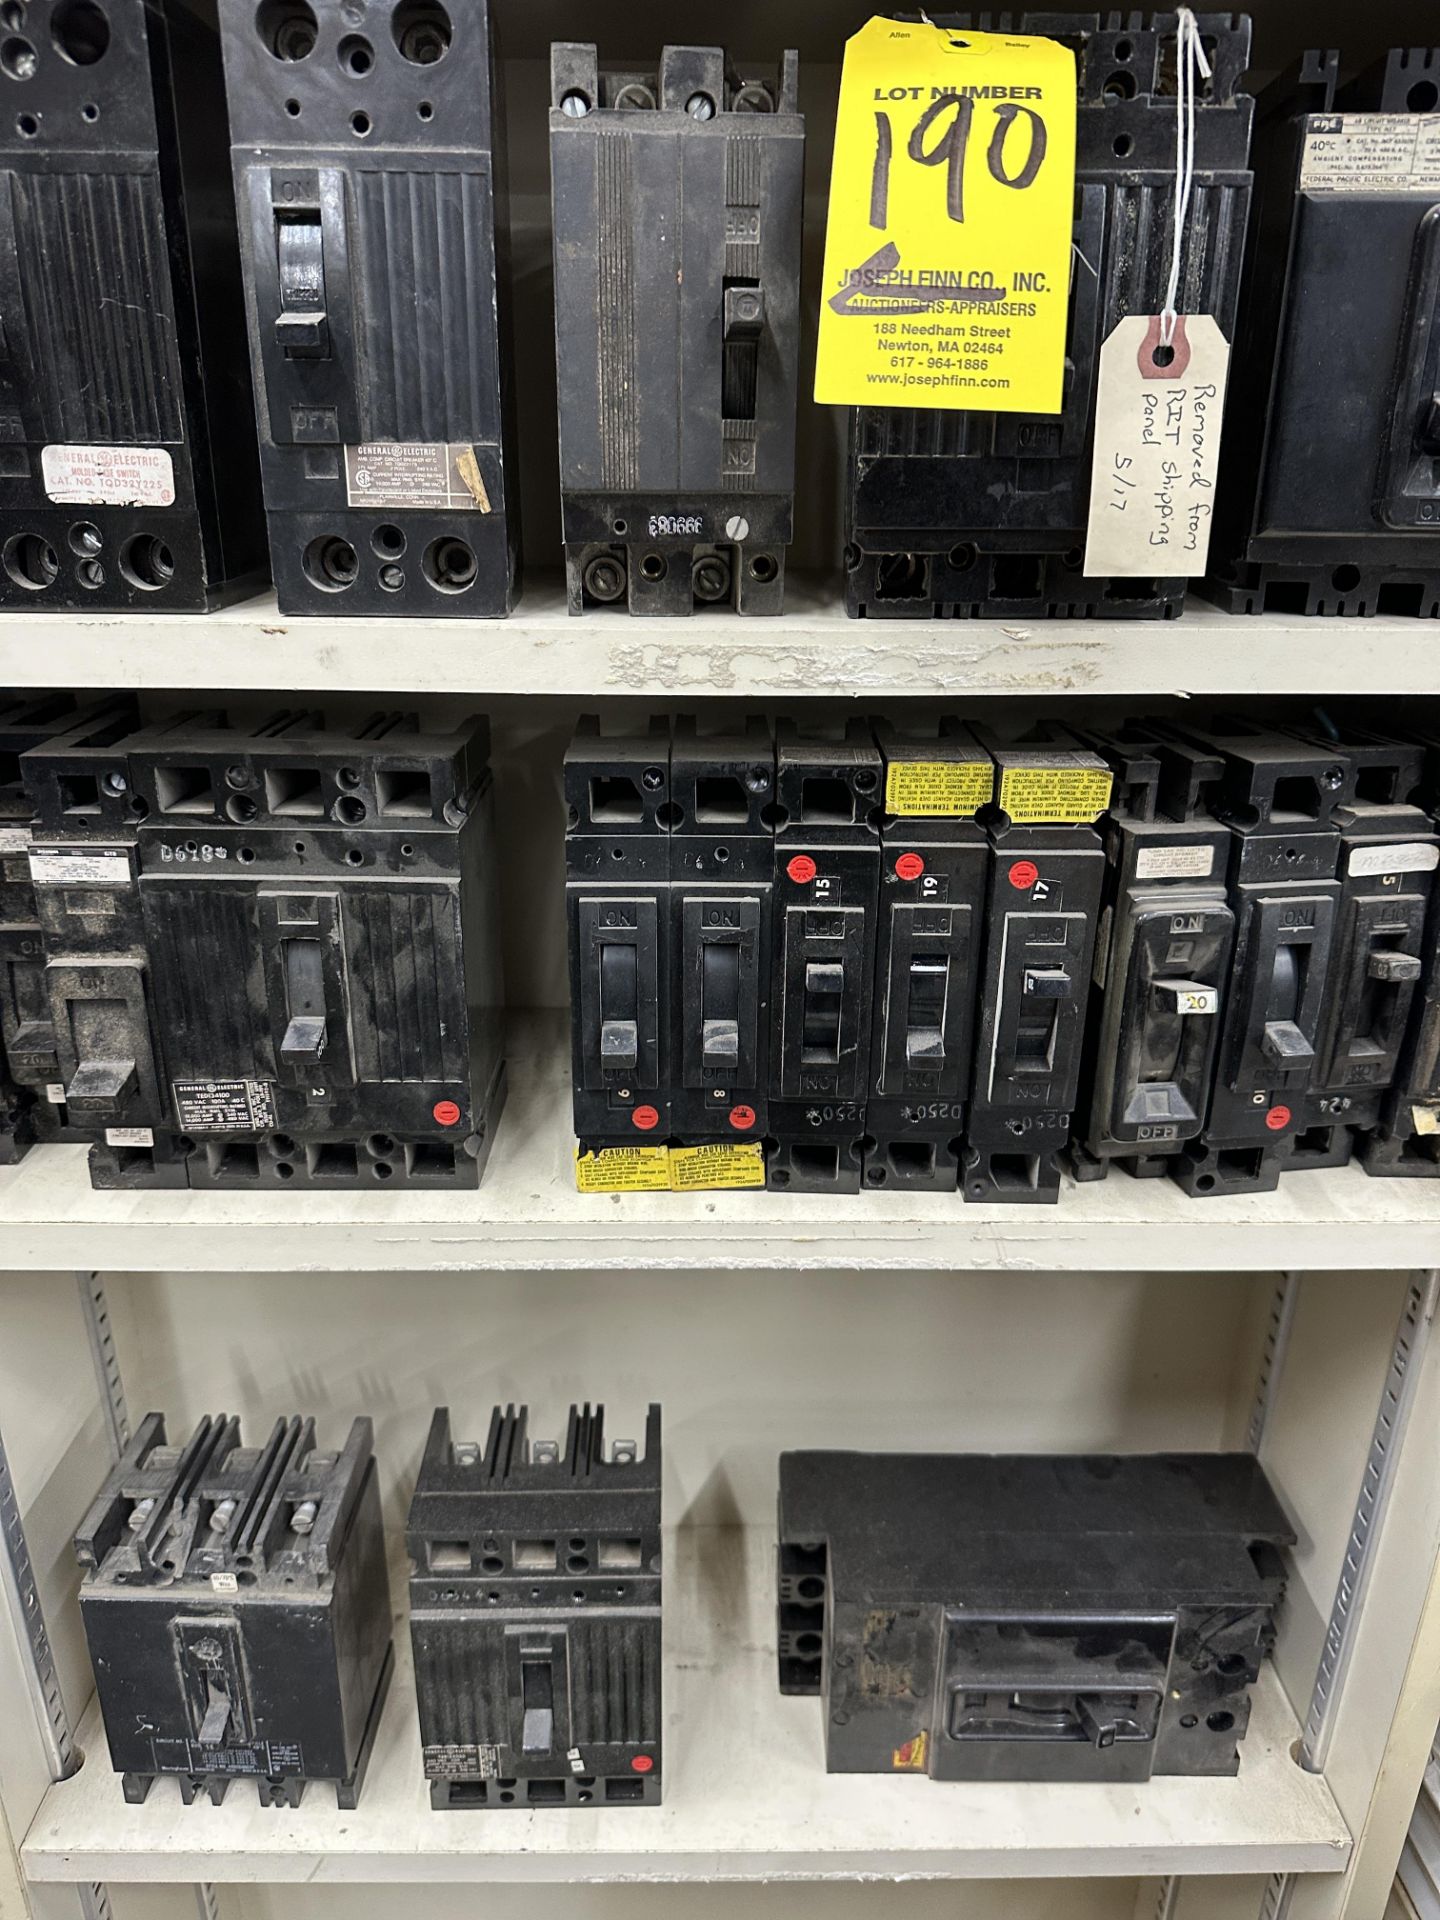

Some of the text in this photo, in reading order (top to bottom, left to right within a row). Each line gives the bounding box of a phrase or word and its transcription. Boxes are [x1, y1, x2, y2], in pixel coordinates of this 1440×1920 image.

[889, 31, 910, 39] Allen
[874, 86, 1043, 101] LOT NUMBER
[869, 94, 1047, 230] 190
[283, 181, 310, 201] ON
[838, 268, 912, 289] JOSEPH
[918, 270, 962, 289] FINN
[1013, 272, 1051, 292] INC.
[850, 299, 1036, 317] AUCTIONEERS-APPRAISERS
[873, 323, 1011, 338] 188 Needham Street
[878, 339, 1004, 355] Newton, MA 02464
[890, 356, 915, 368] 617
[927, 357, 989, 371] 964-1886
[867, 373, 1010, 389] www.josephfinn.com
[295, 413, 335, 430] OFF
[358, 447, 436, 456] GENERAL ELECTRIC
[727, 447, 751, 466] ON
[114, 455, 160, 466] ELECTRIC
[1183, 384, 1216, 551] Removed from
[116, 469, 141, 477] SWITCH
[51, 477, 72, 486] CAT.
[76, 478, 95, 487] NO.
[1110, 452, 1136, 511] 5/17
[816, 879, 830, 897] 15
[923, 877, 938, 897] 19
[1383, 876, 1396, 885] 5
[1032, 881, 1049, 901] 17
[607, 912, 631, 926] ON
[709, 911, 733, 926] ON
[1173, 915, 1199, 929] ON
[1285, 909, 1309, 926] ON
[807, 921, 843, 936] OFF
[1028, 928, 1063, 941] OFF
[1187, 996, 1207, 1009] 20
[312, 1088, 325, 1096] 2
[713, 1089, 726, 1097] 8
[1016, 1083, 1041, 1098] ON
[1253, 1090, 1266, 1104] 10
[1141, 1127, 1174, 1138] OFF
[604, 1149, 640, 1157] CAUTION
[697, 1145, 734, 1154] CAUTION
